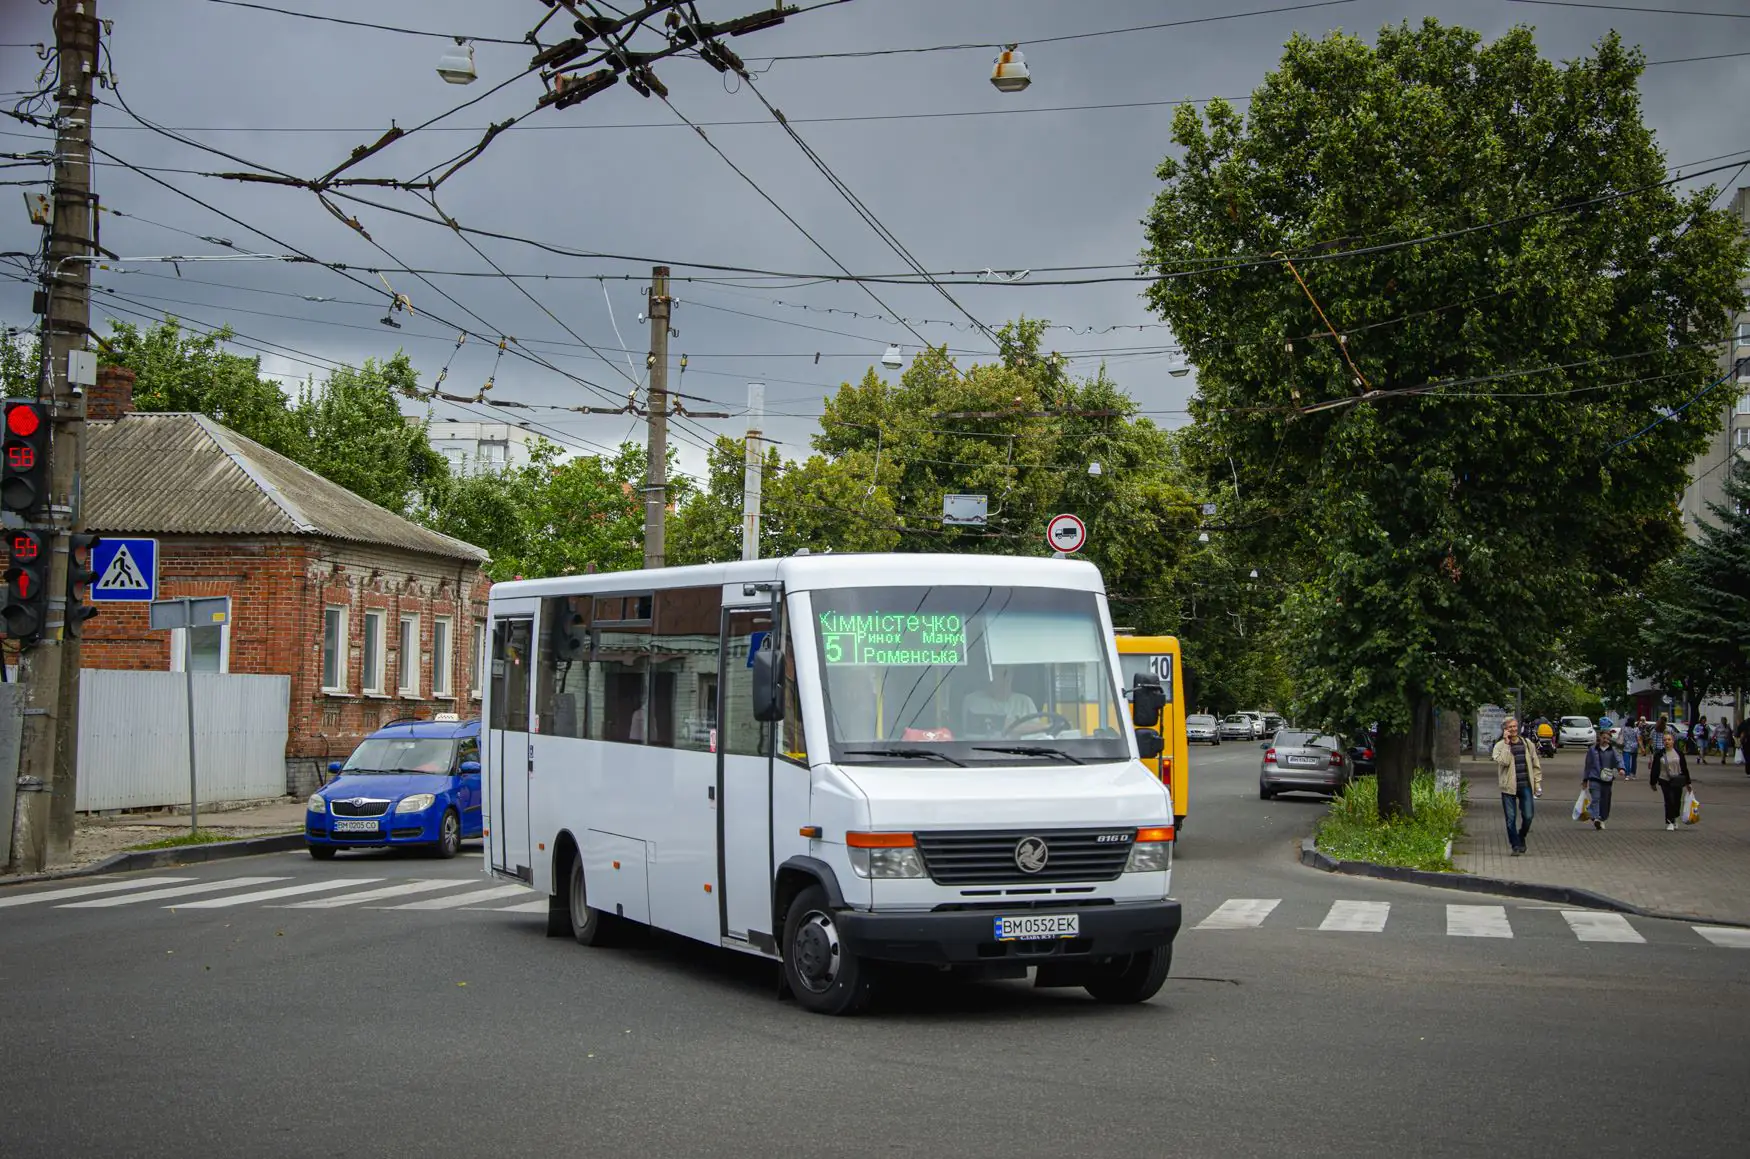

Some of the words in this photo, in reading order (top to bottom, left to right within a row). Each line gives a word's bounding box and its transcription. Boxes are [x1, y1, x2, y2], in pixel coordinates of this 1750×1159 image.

[9, 447, 34, 467] 58
[857, 630, 901, 644] Ринок
[826, 635, 842, 662] 5
[863, 647, 958, 664] Роменська
[1151, 656, 1170, 680] 10
